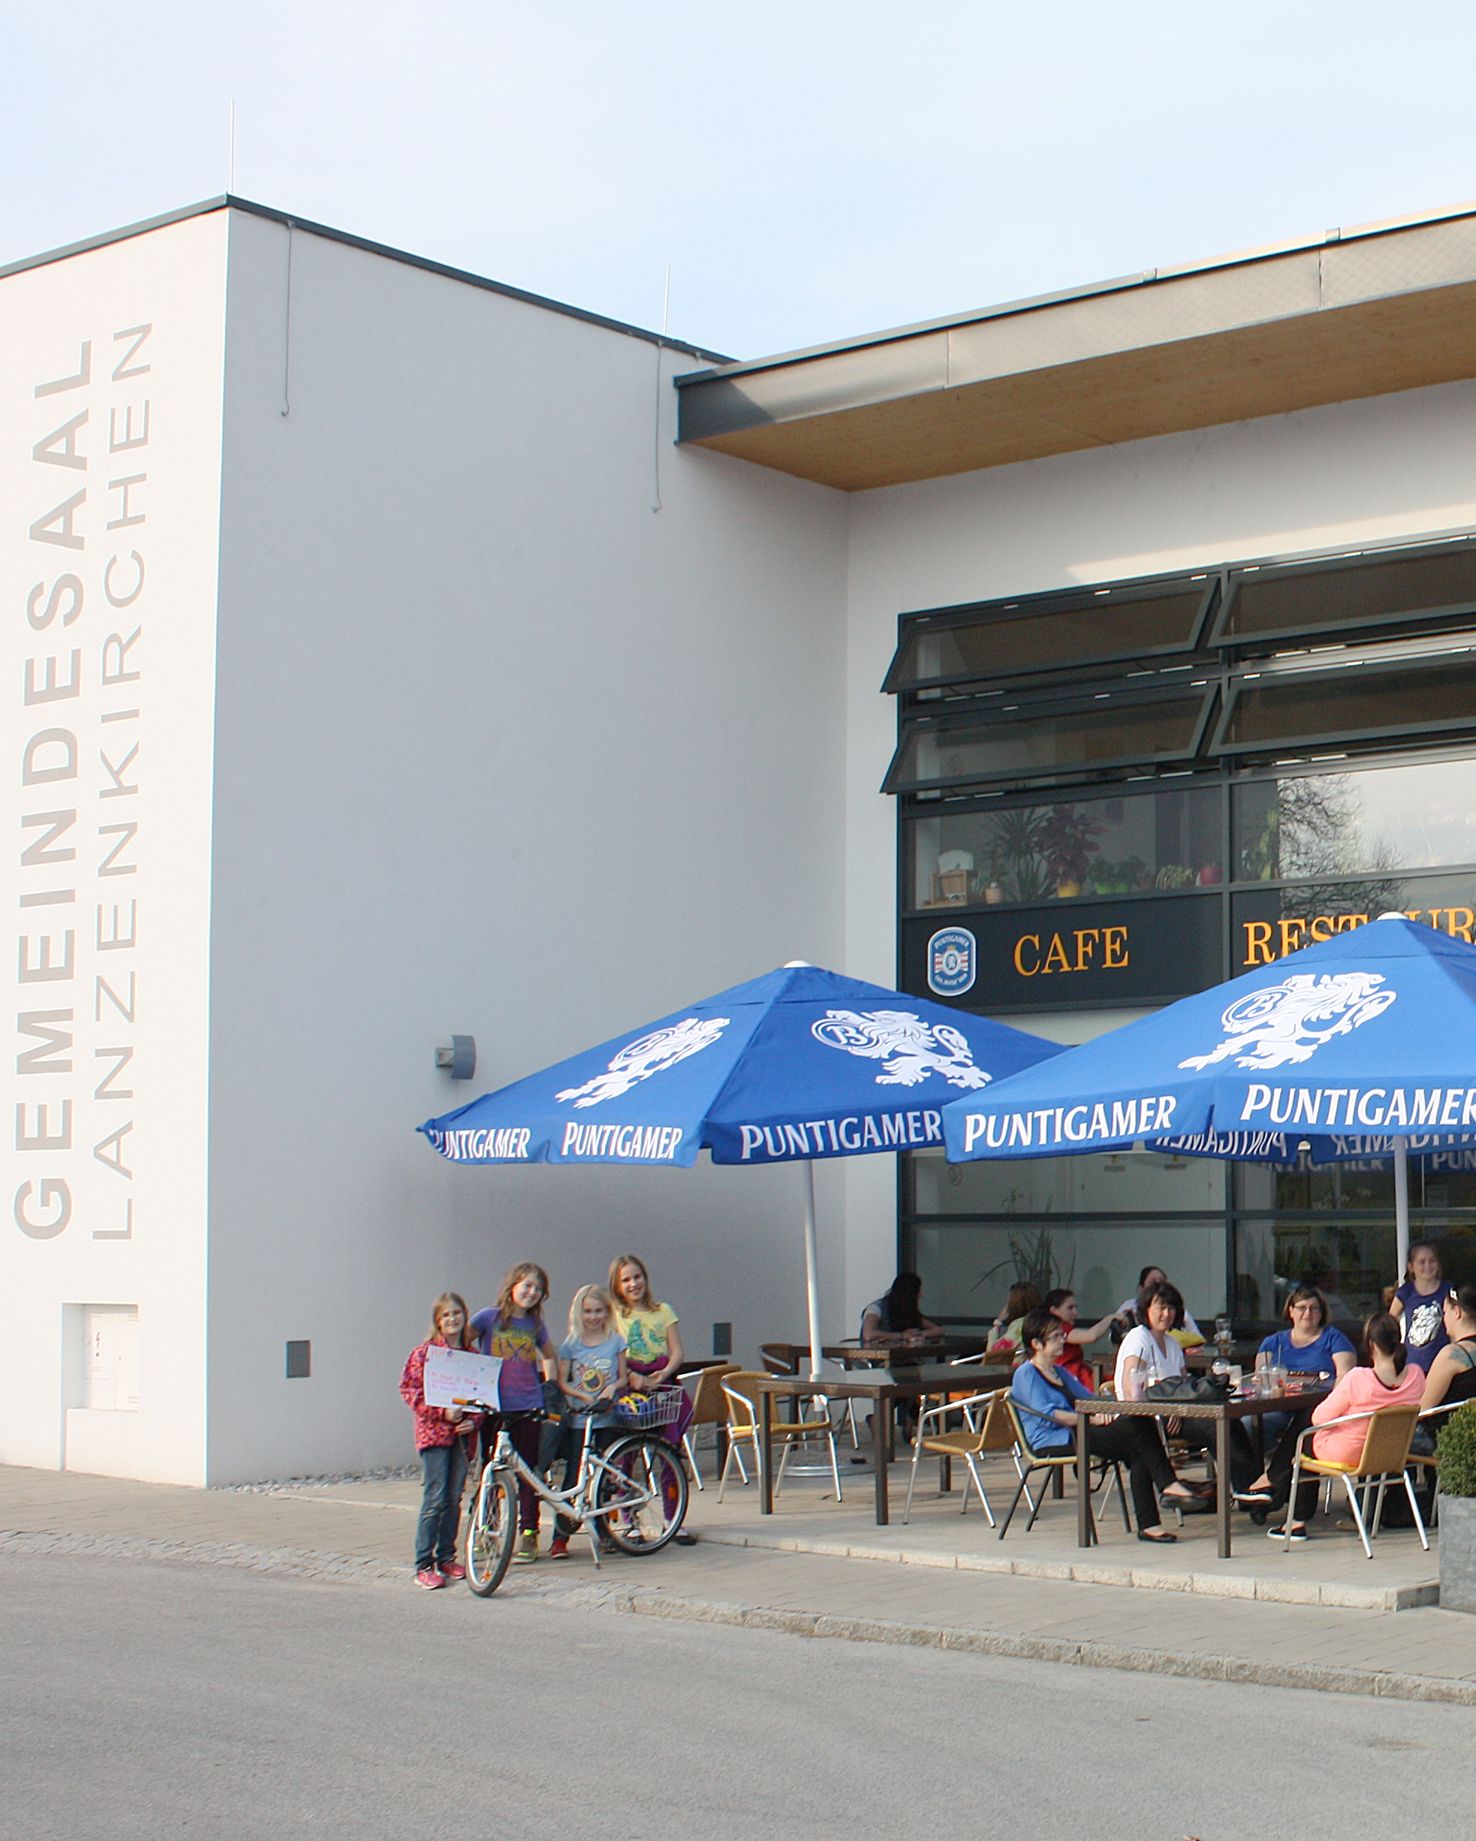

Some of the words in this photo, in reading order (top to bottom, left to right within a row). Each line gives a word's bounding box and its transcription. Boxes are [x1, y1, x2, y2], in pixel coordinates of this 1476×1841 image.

[14, 339, 92, 1240] GEMEINDESAAL
[92, 322, 152, 1240] LANZENKIRCHEN
[1014, 926, 1131, 977] CAFE
[561, 1121, 683, 1160] PUNTIGAMER
[740, 1109, 942, 1160] PUNTIGAMER
[964, 1096, 1177, 1153] PUNTIGAMER
